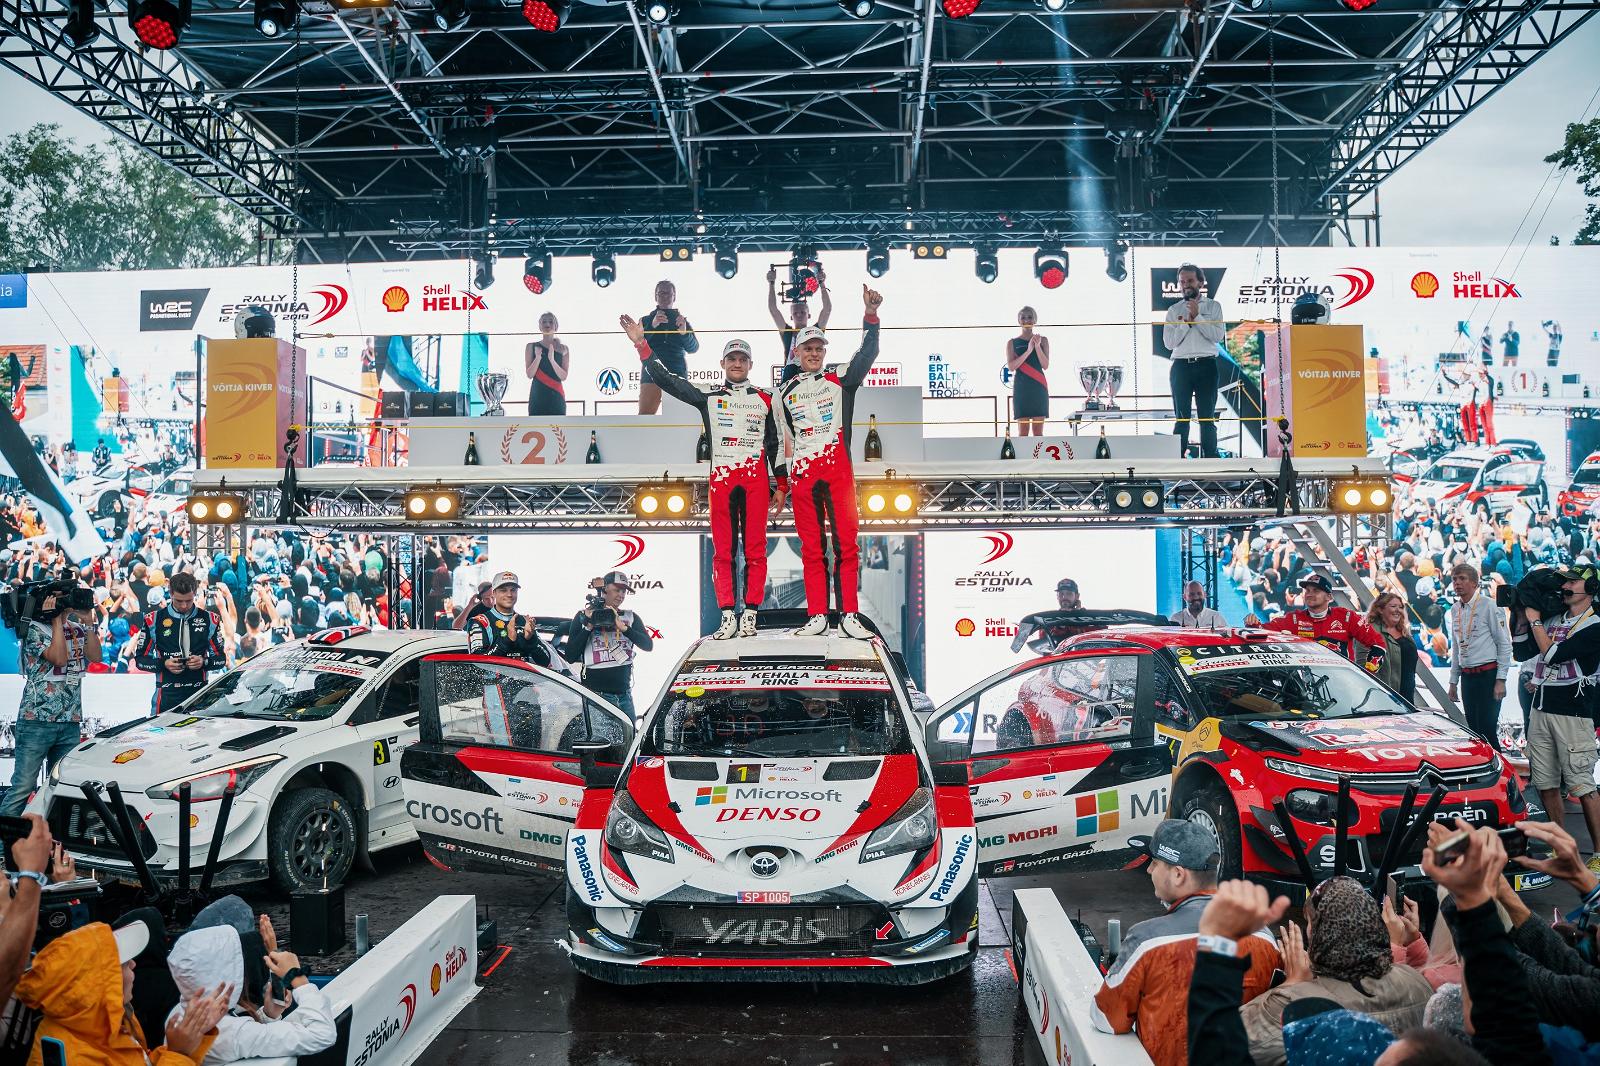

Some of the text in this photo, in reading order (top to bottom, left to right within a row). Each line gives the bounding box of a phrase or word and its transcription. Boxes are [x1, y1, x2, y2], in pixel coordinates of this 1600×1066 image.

[1262, 276, 1310, 284] RALLY
[1453, 271, 1481, 282] Shell
[423, 284, 451, 295] Shell
[1239, 285, 1335, 296] ESTONIA
[1453, 283, 1520, 298] HELIX
[242, 294, 287, 303] RALLY
[423, 294, 488, 311] HELIX
[150, 301, 193, 313] WRC
[879, 367, 898, 375] PLACE
[1298, 368, 1361, 379] VÕITJA KIIVER
[212, 382, 273, 392] VÕITJA KIIVER
[730, 402, 763, 411] Microsoft
[520, 431, 546, 464] 2
[1045, 446, 1061, 460] 3
[954, 577, 1033, 586] ESTONIA
[985, 618, 1006, 626] Shell
[1247, 652, 1293, 661] KEHALA
[760, 678, 799, 686] RING
[374, 740, 385, 765] 3
[1347, 744, 1473, 762] TOTAL
[737, 766, 748, 782] 1
[735, 788, 842, 802] Microsoft
[1036, 790, 1057, 798] HELIX
[406, 799, 504, 835] crosoft
[716, 807, 821, 823] DENSO
[519, 829, 563, 846] DMG
[1008, 825, 1058, 843] MORI
[458, 845, 498, 860] TOYOTA
[500, 855, 537, 868] GAZOO
[652, 849, 670, 860] PIAA
[675, 839, 716, 864] DMG MORI
[814, 839, 858, 865] DMG MORI
[865, 850, 886, 860] PIAA
[1159, 843, 1181, 858] WRC
[571, 834, 603, 902] Panasonic
[929, 834, 973, 902] Panasonic
[1016, 855, 1060, 869] TOYOTA
[607, 872, 640, 896] KONECRANES
[894, 872, 931, 897] KONECRANES
[744, 892, 788, 902] SP 1005
[445, 947, 468, 983] HELIX
[365, 1015, 390, 1046] RALLY
[353, 1018, 401, 1066] ESTONIA
